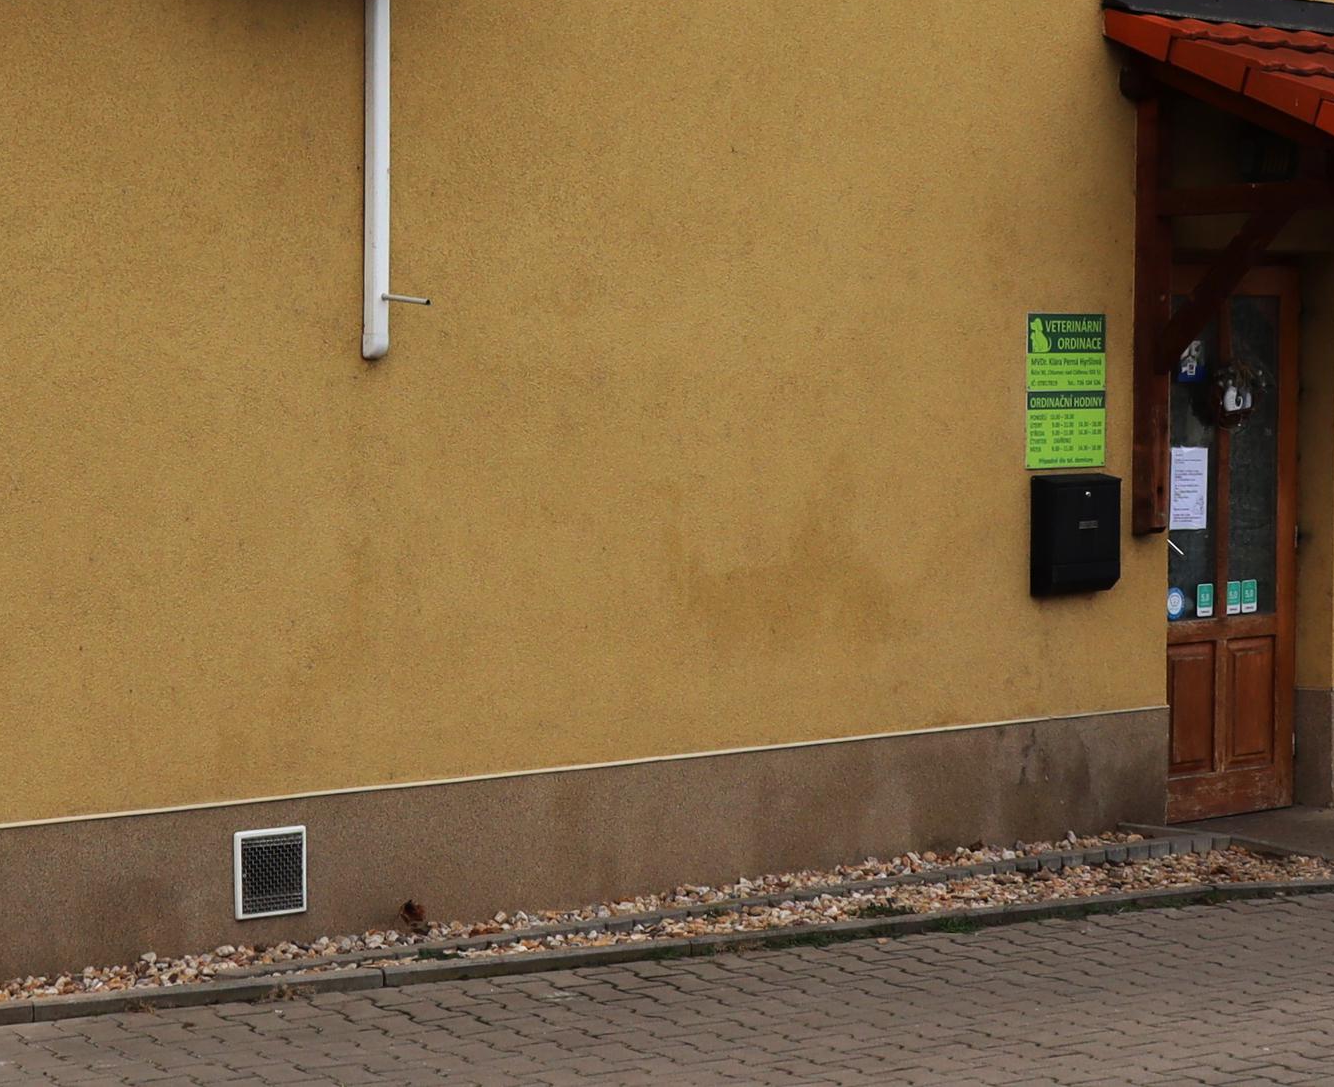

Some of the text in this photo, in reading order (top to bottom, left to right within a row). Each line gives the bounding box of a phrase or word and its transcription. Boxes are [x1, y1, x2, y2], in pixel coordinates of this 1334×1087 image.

[1045, 318, 1102, 333] VETERINÁRNÍ
[1057, 337, 1102, 350] ORDINACE
[1030, 394, 1104, 408] ORDINAČNÍ HODINY
